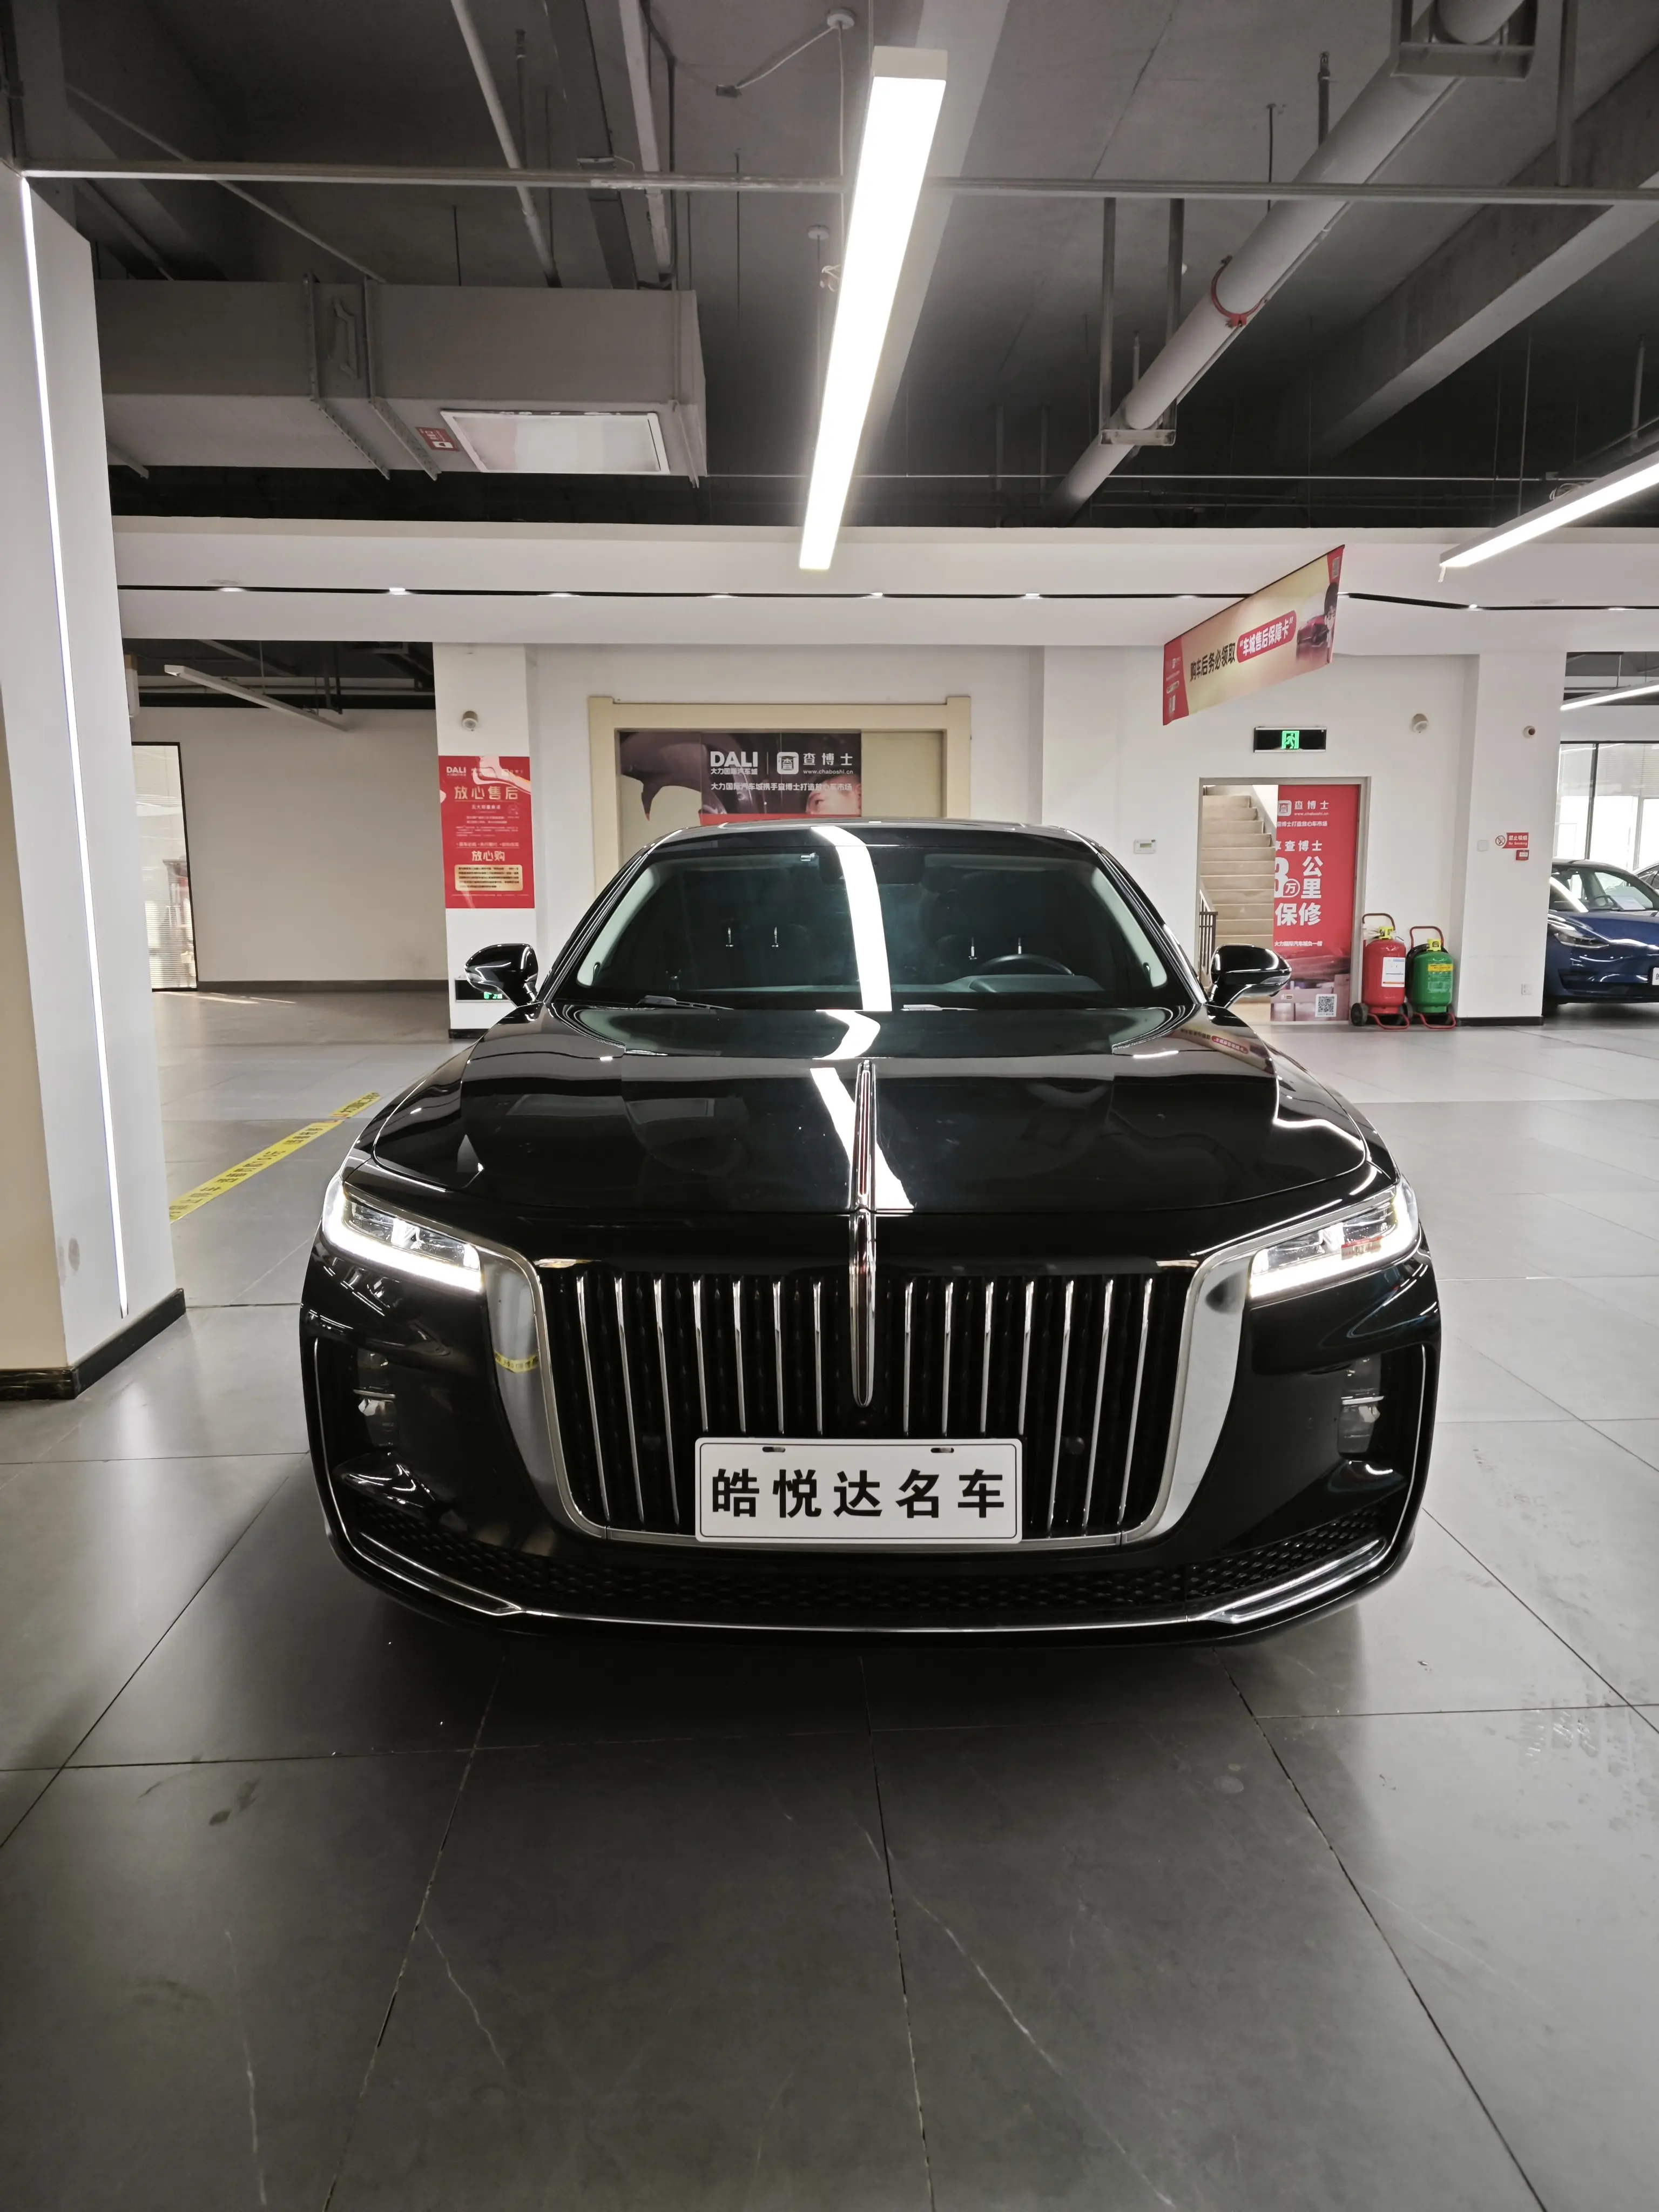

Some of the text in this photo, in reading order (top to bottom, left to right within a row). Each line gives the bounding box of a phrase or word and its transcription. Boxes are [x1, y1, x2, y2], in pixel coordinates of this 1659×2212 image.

[1190, 643, 1236, 682] 购车后务必领取
[710, 751, 758, 767] DALI
[802, 752, 853, 766] 查博士
[454, 786, 518, 800] 放心售后
[1294, 800, 1330, 810] 查博士
[471, 851, 505, 861] 放心购
[1274, 902, 1322, 926] 保修
[711, 1468, 1004, 1519] 皓悦达名车
